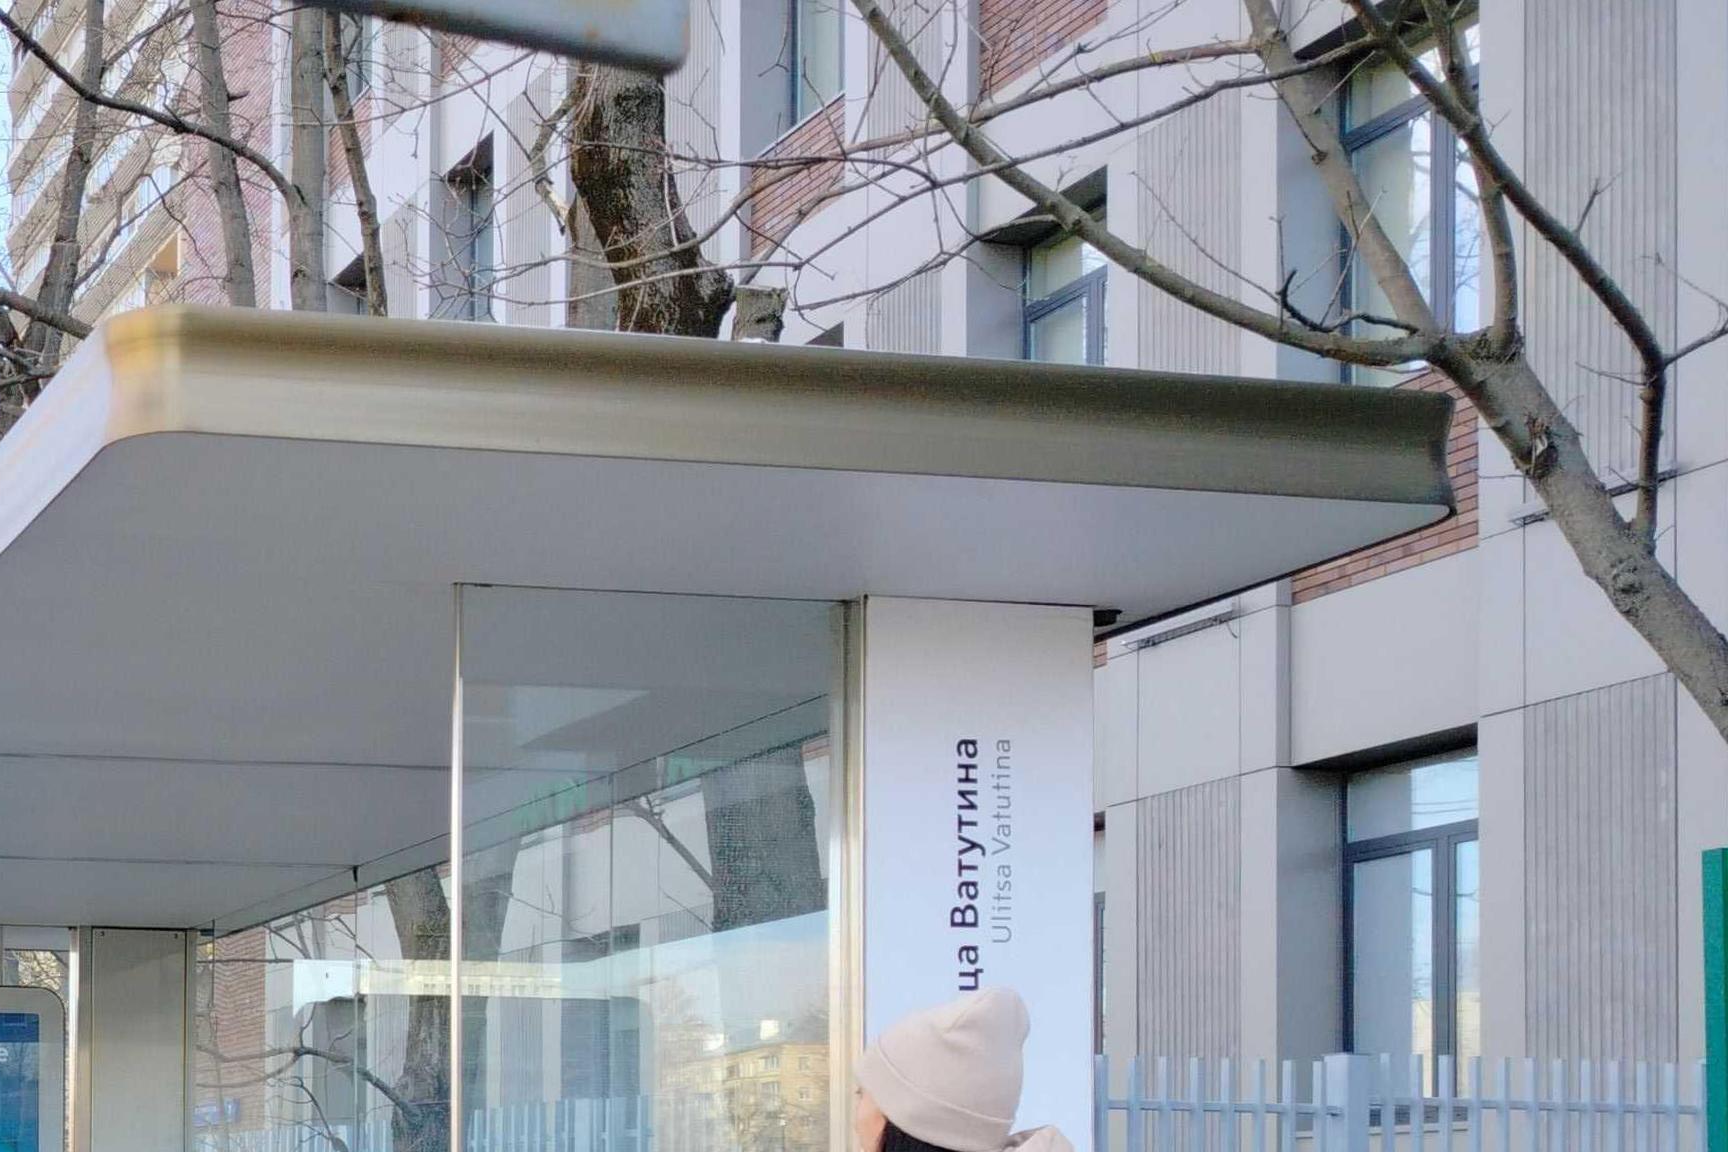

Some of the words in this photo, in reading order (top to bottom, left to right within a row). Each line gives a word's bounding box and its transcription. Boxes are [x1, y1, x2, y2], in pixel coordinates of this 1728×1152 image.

[950, 738, 986, 928] Ватутина
[991, 738, 1011, 855] Vatutina
[991, 863, 1012, 944] Ulitsa
